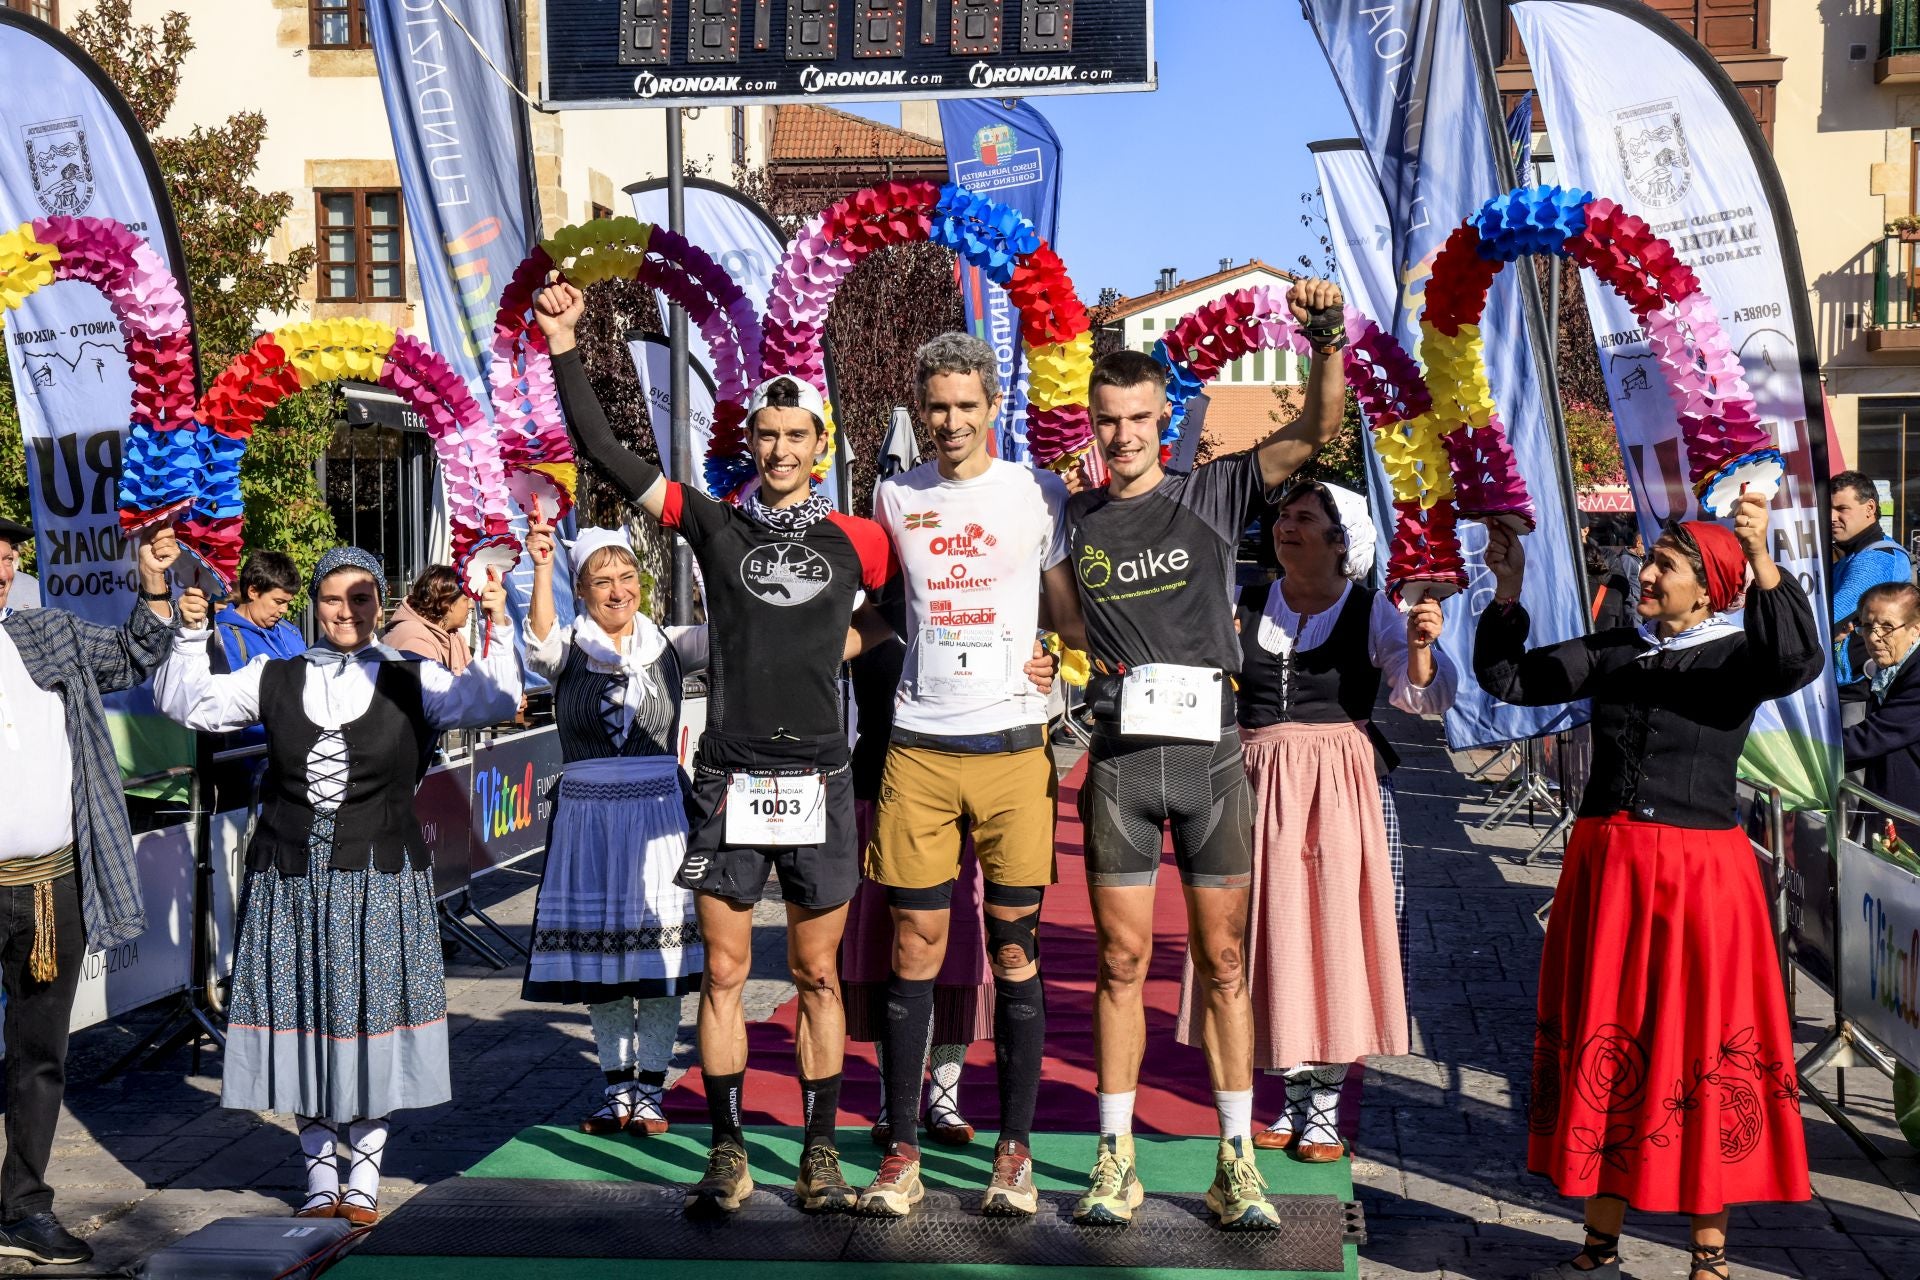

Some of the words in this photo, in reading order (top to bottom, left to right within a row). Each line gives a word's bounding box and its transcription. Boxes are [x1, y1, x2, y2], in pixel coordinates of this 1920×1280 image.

[929, 534, 973, 556] Ortu
[1117, 548, 1190, 583] aike
[927, 577, 993, 591] babiotec
[936, 627, 962, 641] Vital
[956, 640, 993, 648] HAUNDIAK
[957, 651, 967, 668] 1
[476, 761, 534, 843] Vital
[749, 799, 801, 816] 1003
[1862, 891, 1920, 1030] Vital
[729, 1086, 740, 1128] SALOMON
